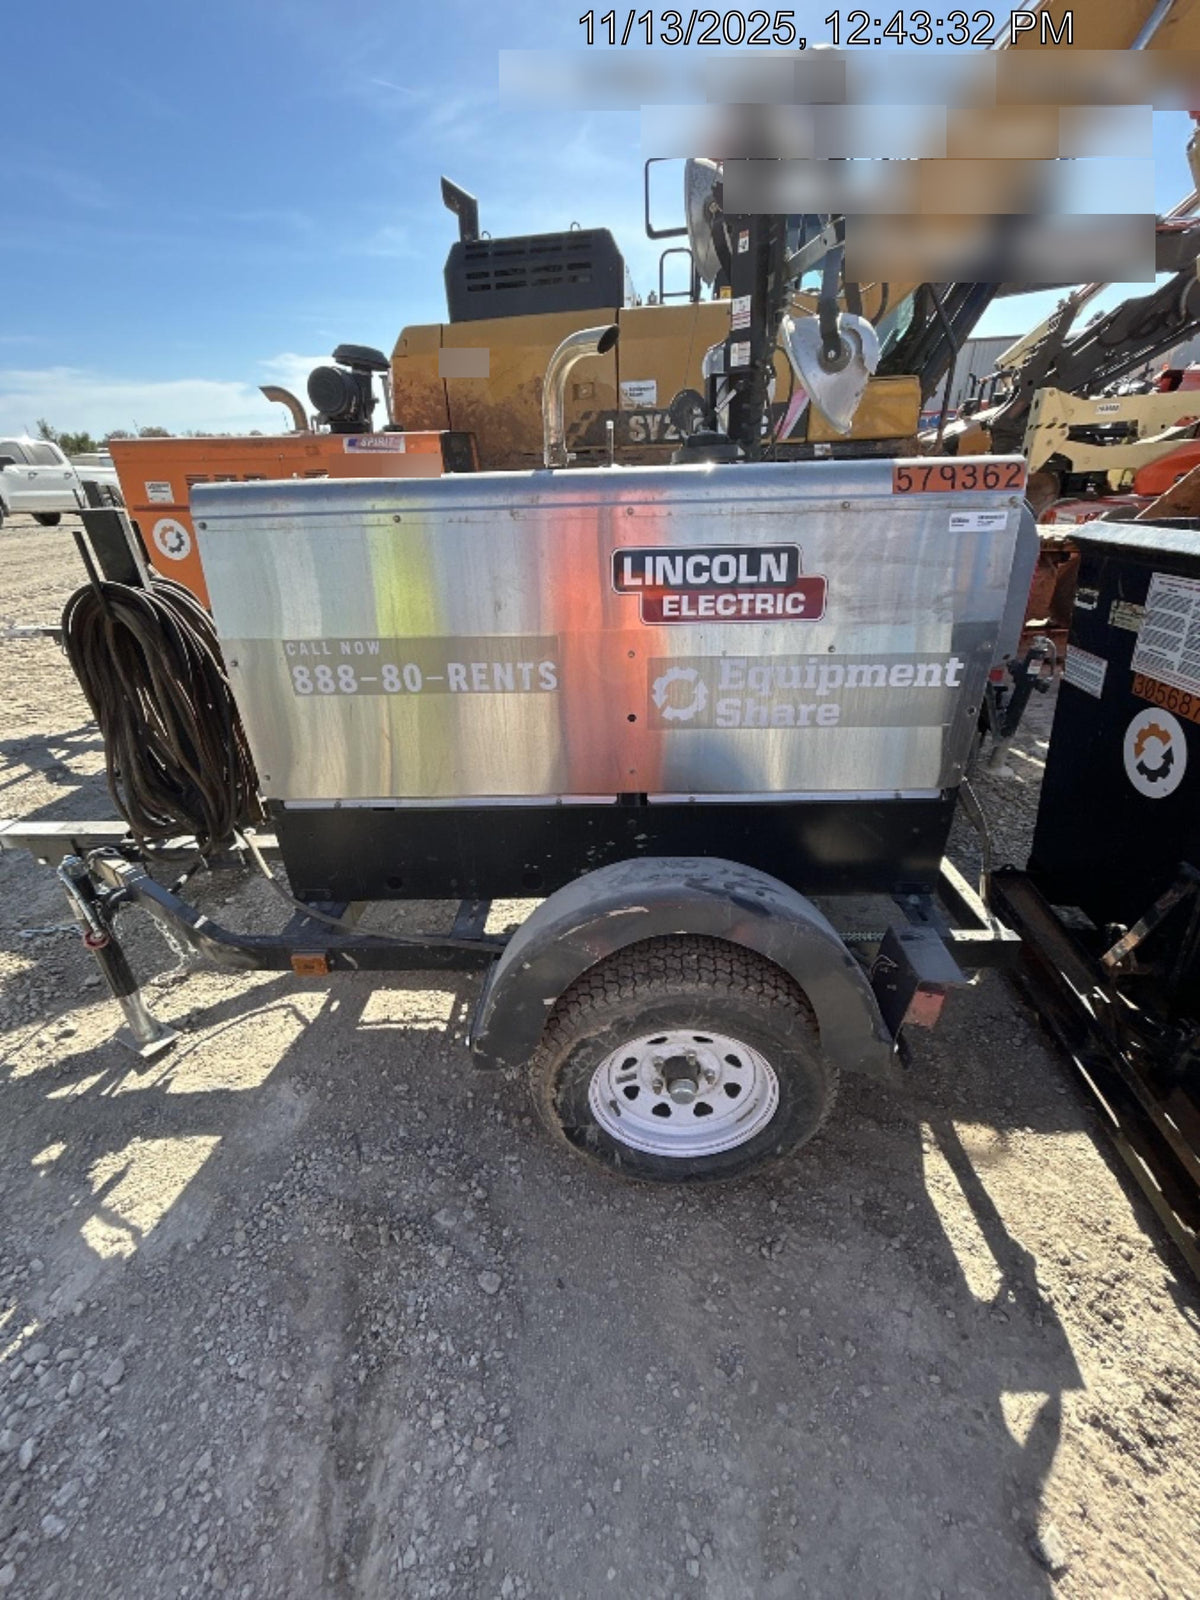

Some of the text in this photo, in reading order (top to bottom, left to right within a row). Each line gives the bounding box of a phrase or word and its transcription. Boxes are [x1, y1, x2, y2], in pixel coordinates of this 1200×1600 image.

[896, 462, 1022, 492] 579362
[623, 552, 789, 585] LINCOLN
[662, 592, 806, 616] ELECTRIC
[285, 641, 380, 655] CALL NOW
[292, 660, 558, 694] 888-80-RENTS
[716, 657, 964, 696] Equipment
[715, 697, 841, 727] Share
